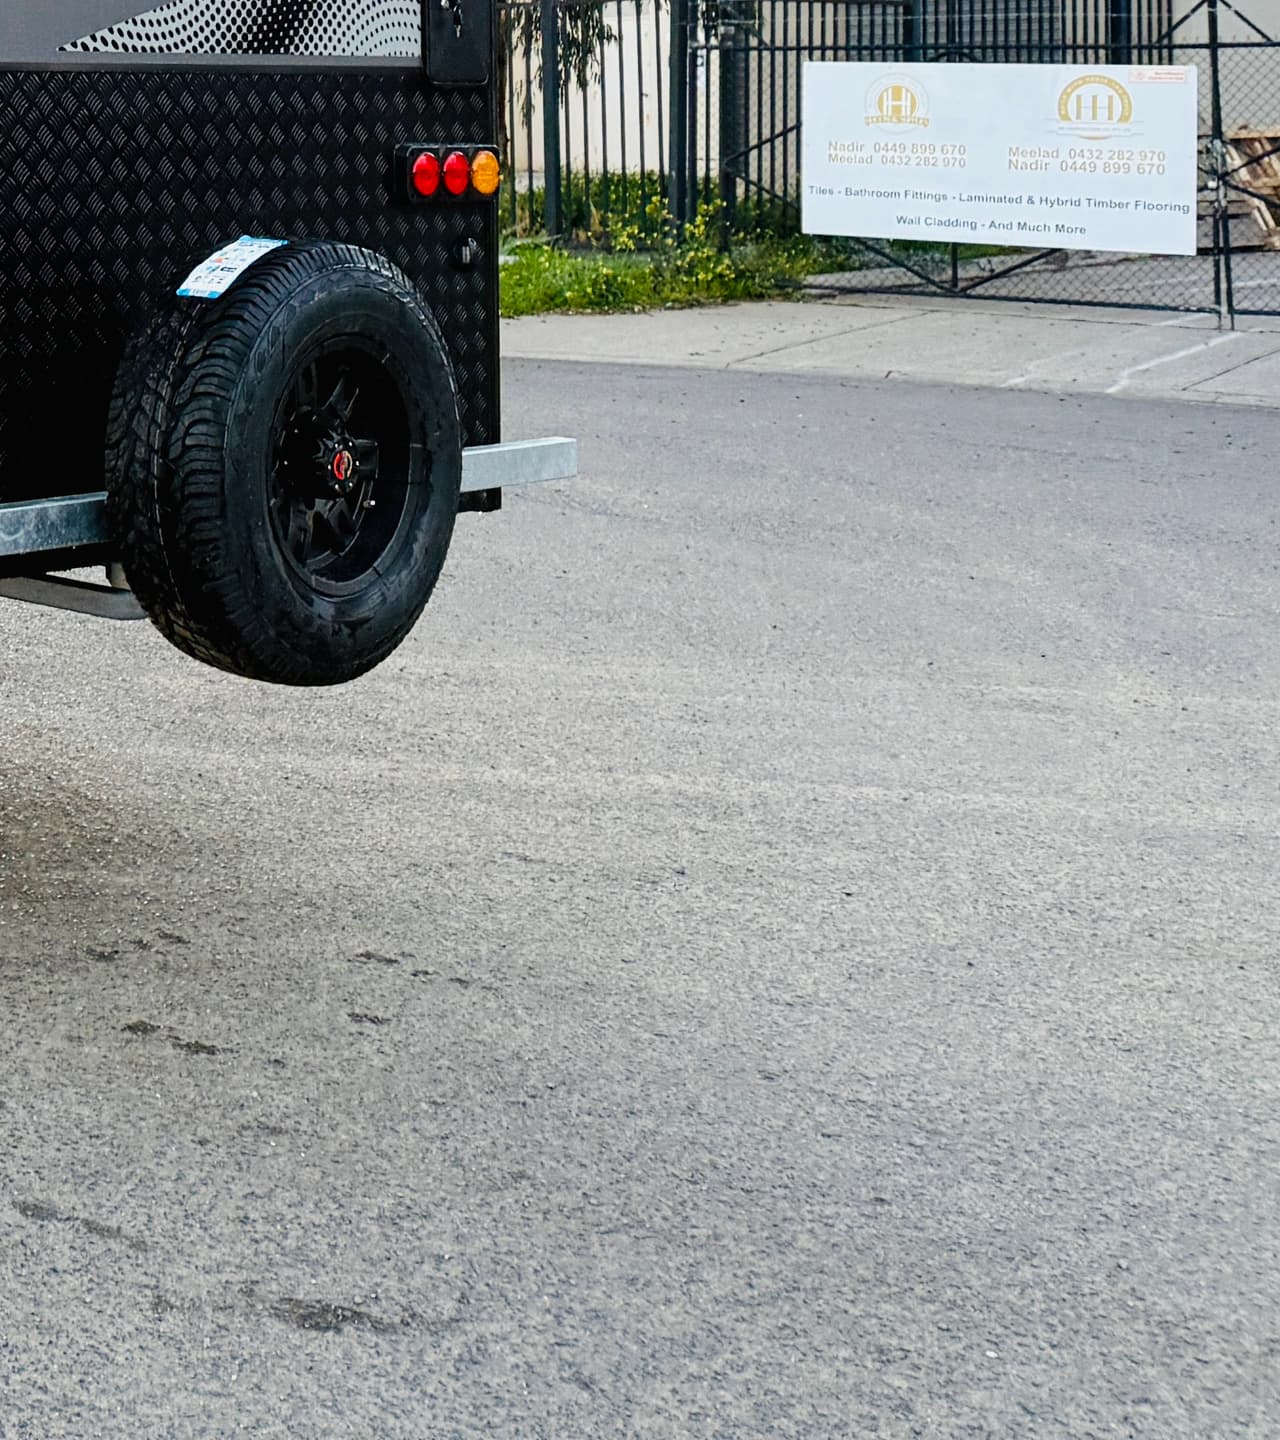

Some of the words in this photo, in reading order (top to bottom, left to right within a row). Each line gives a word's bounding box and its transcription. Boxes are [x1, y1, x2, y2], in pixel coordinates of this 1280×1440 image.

[828, 141, 865, 153] Nadir
[873, 142, 907, 154] 0449
[911, 143, 936, 154] 899
[1008, 146, 1060, 159] Meelad
[1068, 148, 1103, 160] 0432
[1108, 149, 1135, 161] 282
[1139, 150, 1166, 162] 970
[828, 154, 873, 165] Meelad
[881, 155, 911, 166] 0432
[915, 156, 939, 167] 282
[1008, 159, 1051, 171] Nadir
[1060, 161, 1097, 173] 0449
[1103, 162, 1131, 174] 899
[1137, 163, 1166, 176] 670
[808, 185, 835, 196] Tiles
[845, 187, 901, 200] Bathroom
[904, 189, 949, 203] Fittings
[959, 192, 1023, 206] Laminated
[1026, 195, 1035, 205] &
[1039, 196, 1082, 209] Hybrid
[1085, 198, 1131, 211] Timber
[1134, 200, 1190, 215] Flooring
[896, 215, 921, 226] Wall
[924, 216, 978, 231] Cladding
[989, 220, 1013, 231] And
[1017, 221, 1051, 233] Much
[1055, 223, 1087, 235] More
